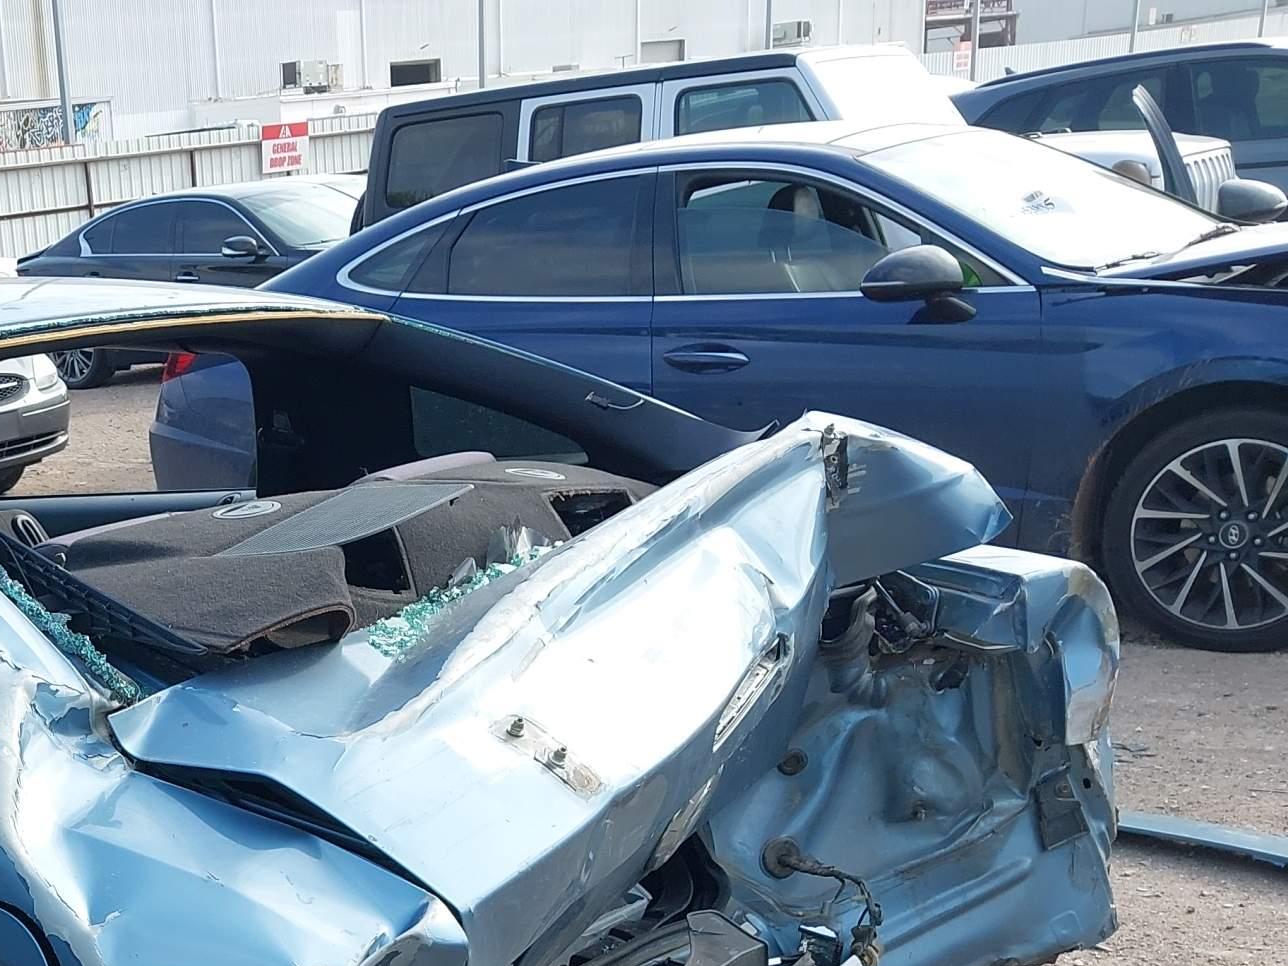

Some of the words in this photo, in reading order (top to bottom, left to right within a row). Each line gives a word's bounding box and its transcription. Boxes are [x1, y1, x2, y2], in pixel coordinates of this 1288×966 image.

[272, 141, 298, 154] GENERAL
[269, 156, 287, 168] DROP
[287, 154, 302, 167] ZONE
